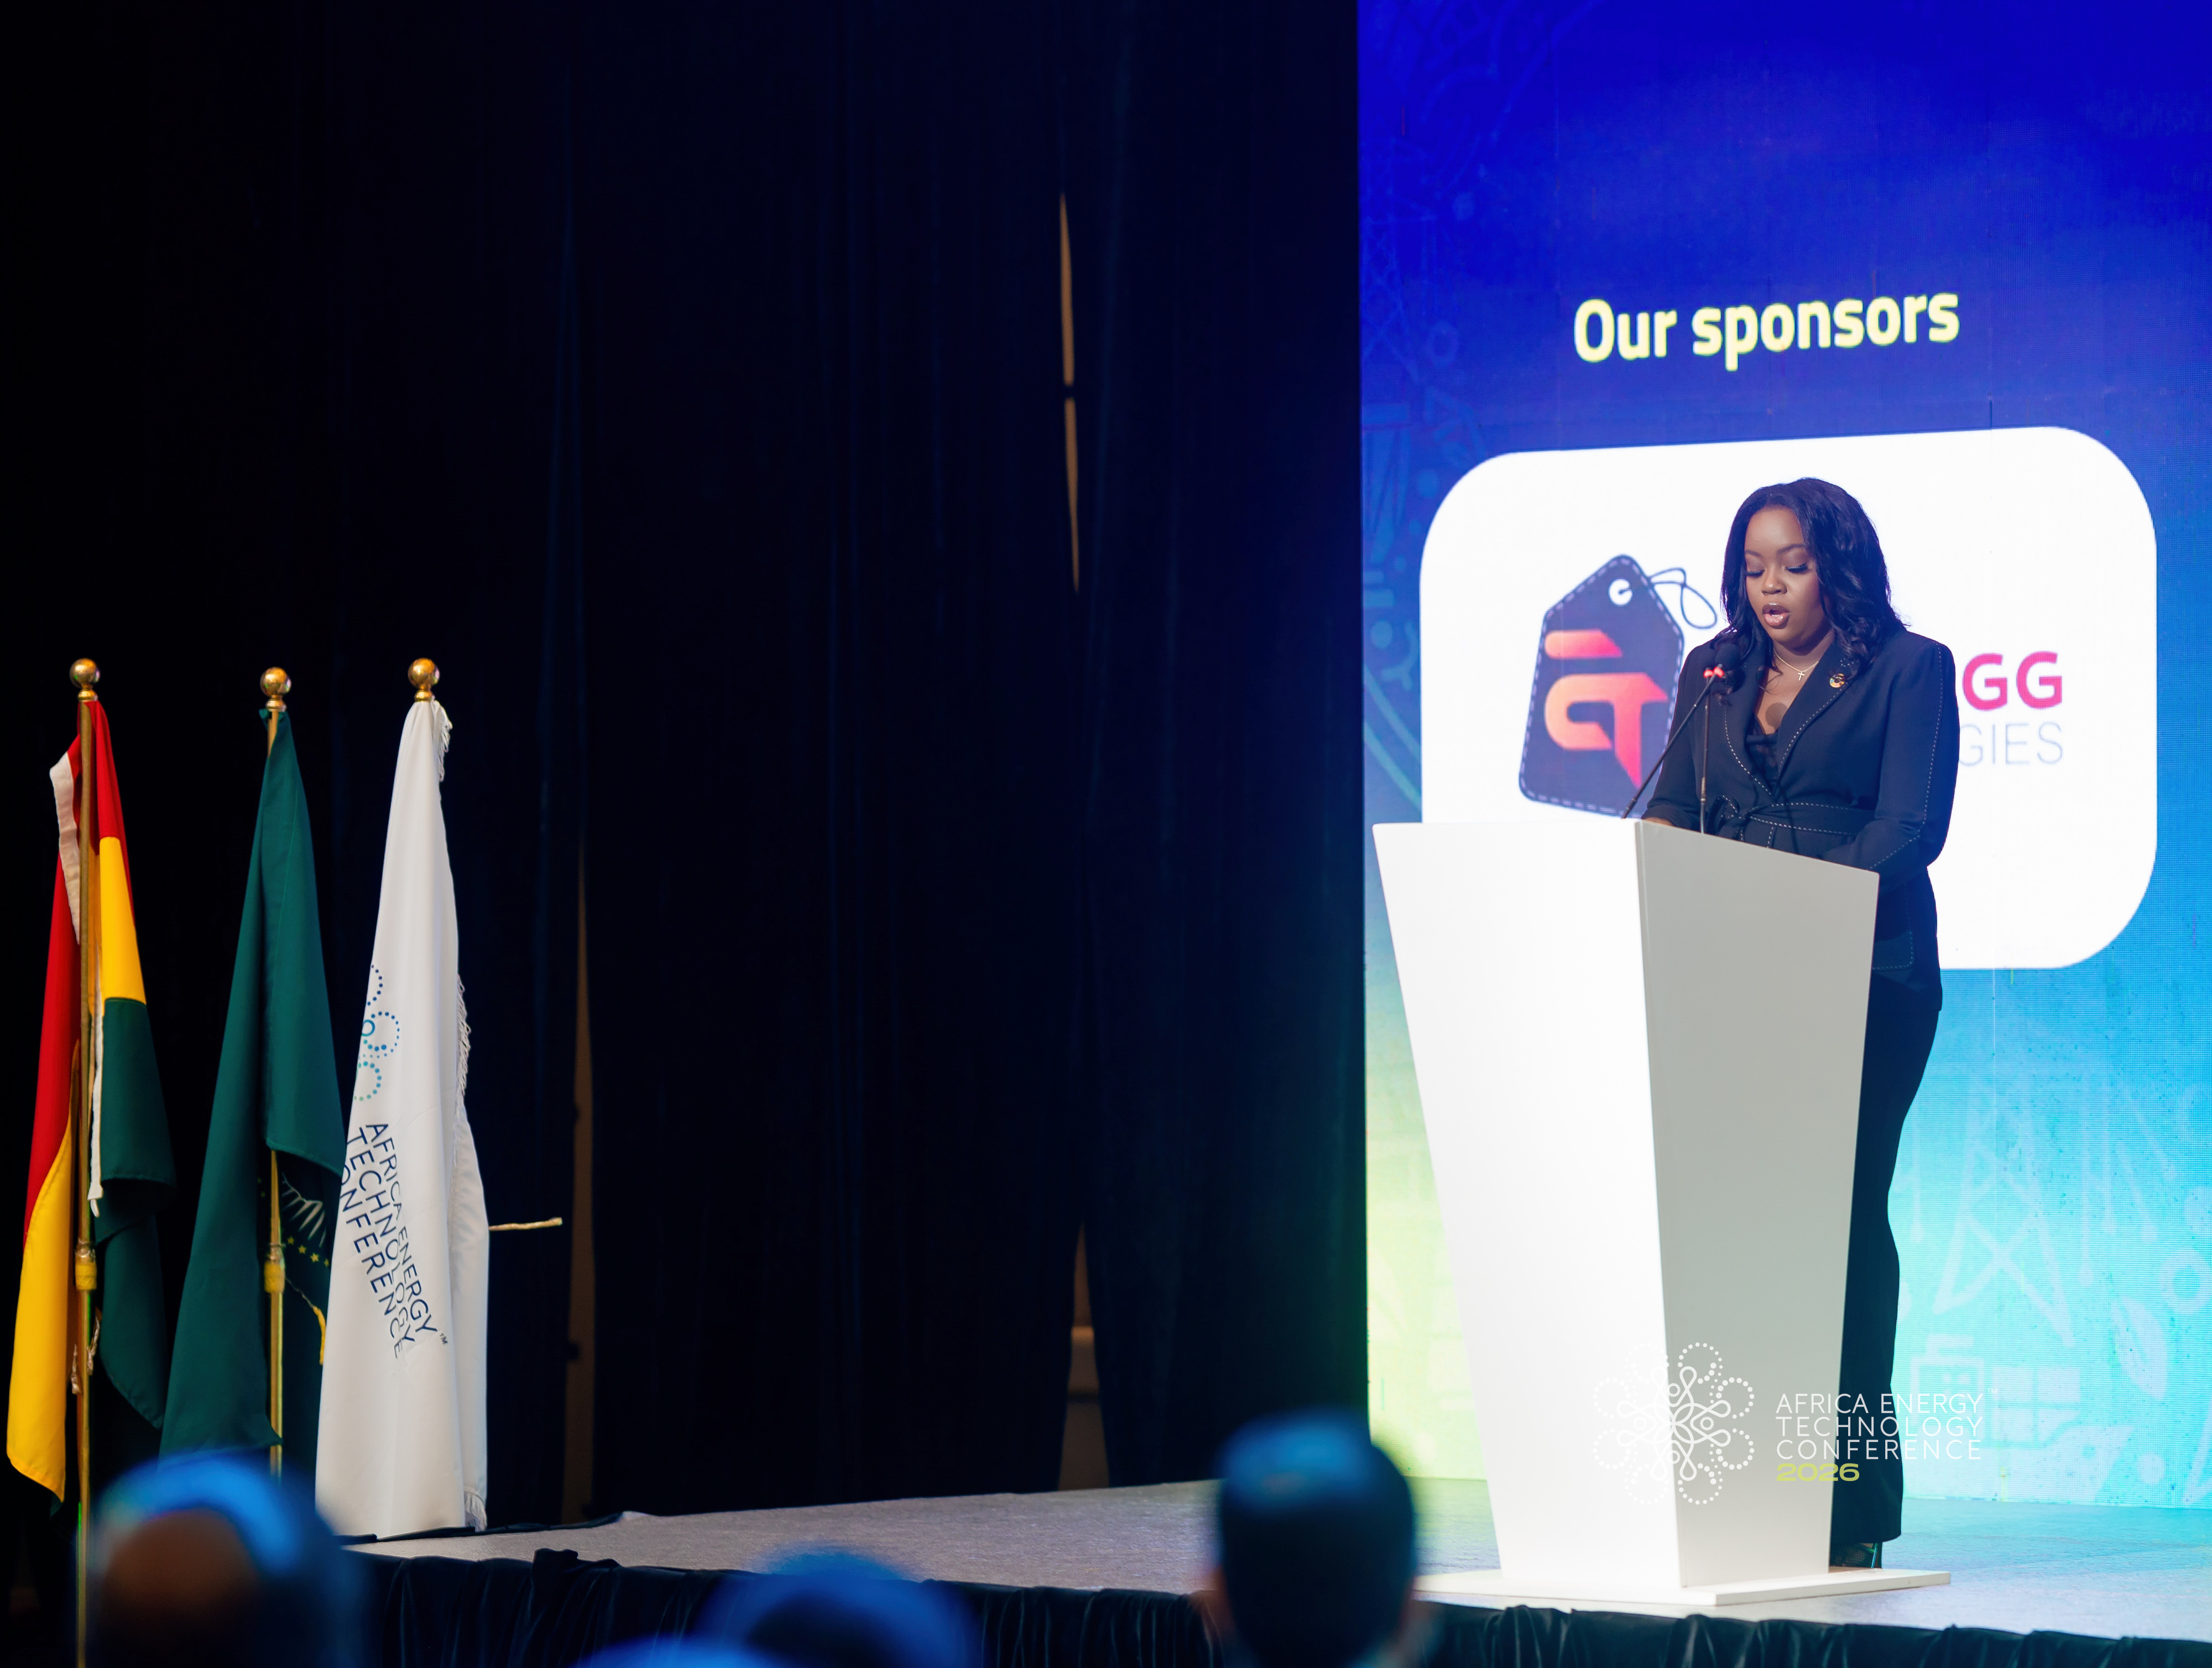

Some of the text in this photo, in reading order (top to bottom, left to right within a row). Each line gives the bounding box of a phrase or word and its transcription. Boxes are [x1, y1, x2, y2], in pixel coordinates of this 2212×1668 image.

[1573, 293, 1960, 372] Our sponsors
[1962, 651, 2063, 712] GG
[1959, 721, 2063, 767] GIES
[347, 1127, 414, 1342] TECHNOLOGY
[366, 1123, 402, 1220] AFRICA
[398, 1226, 437, 1332] ENERGY
